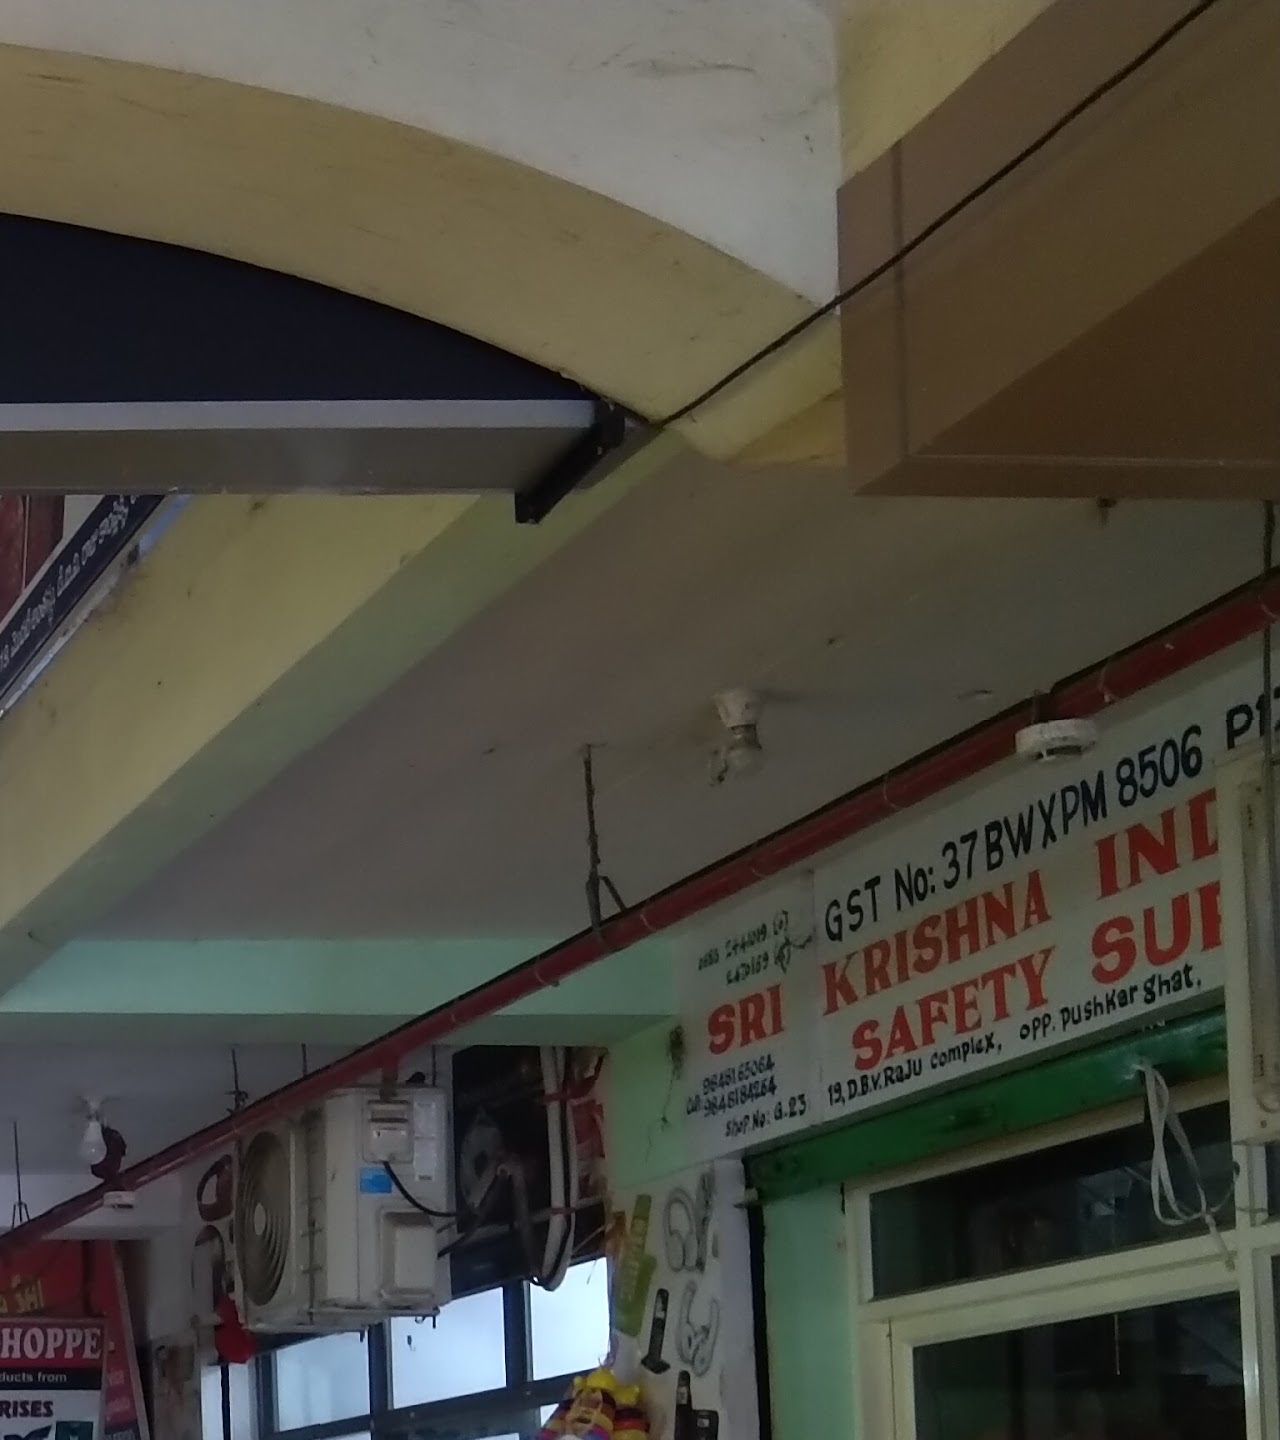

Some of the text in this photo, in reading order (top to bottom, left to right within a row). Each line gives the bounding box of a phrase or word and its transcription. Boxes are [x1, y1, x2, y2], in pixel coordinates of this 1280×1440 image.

[825, 876, 881, 942] GST
[894, 863, 936, 912] No:
[707, 984, 784, 1055] SRI
[822, 869, 1052, 1016] KRISHNA
[852, 946, 1056, 1071] SAFETY
[37, 1370, 68, 1383] from
